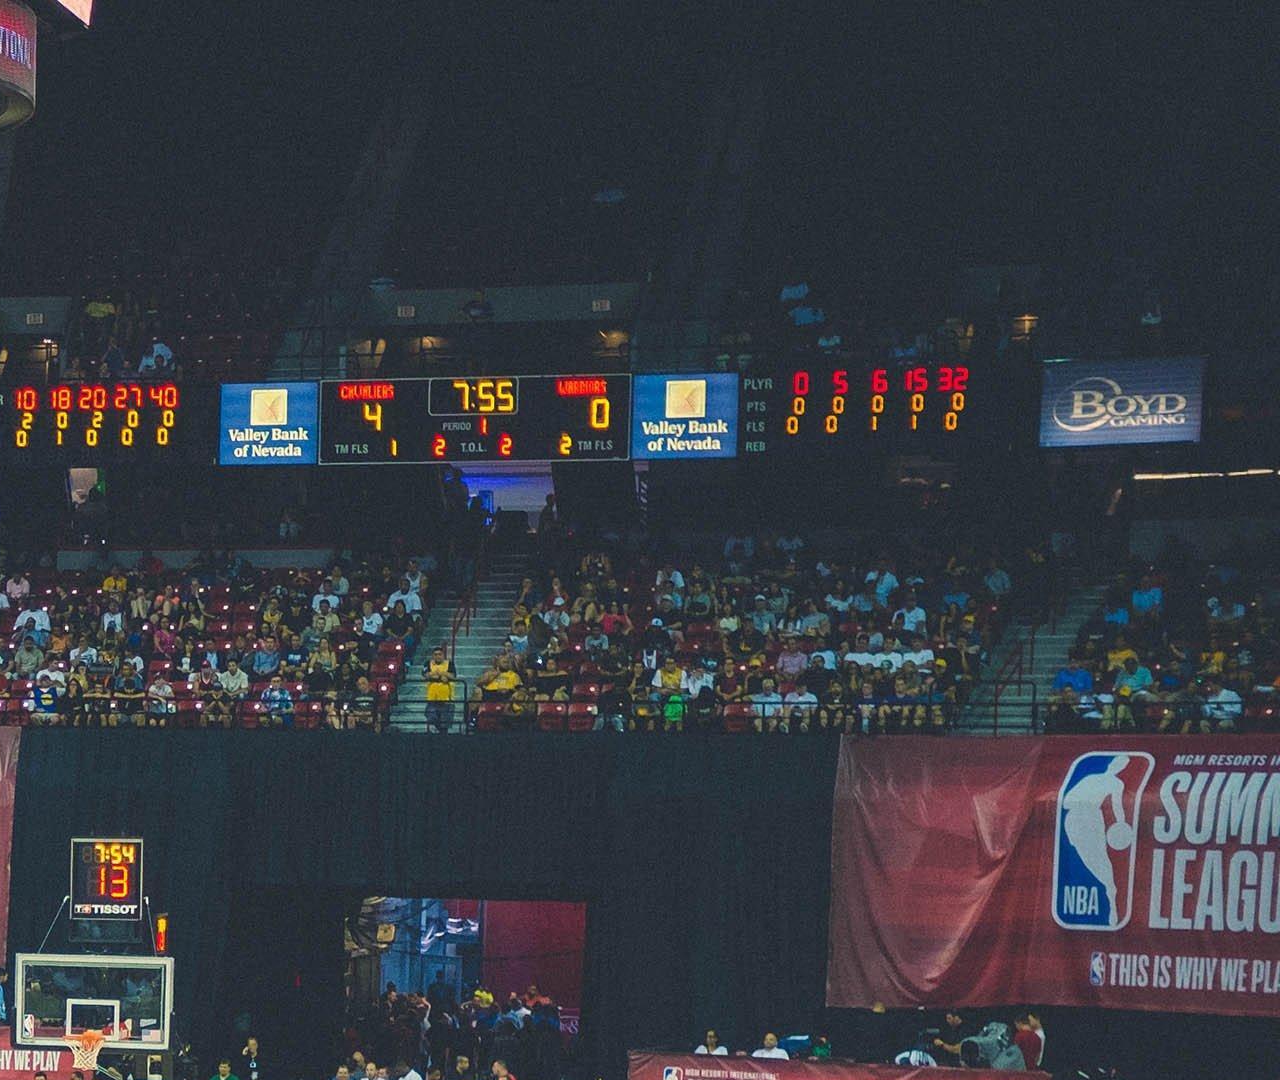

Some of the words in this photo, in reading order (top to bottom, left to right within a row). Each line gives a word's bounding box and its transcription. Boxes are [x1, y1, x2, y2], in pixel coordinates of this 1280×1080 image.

[743, 378, 773, 390] PLYR
[792, 370, 810, 396] 0
[831, 370, 849, 395] 5
[871, 369, 889, 393] 6
[905, 367, 929, 392] 15
[936, 367, 970, 392] 32
[15, 388, 37, 411] 10
[51, 388, 72, 411] 18
[78, 387, 107, 411] 20
[114, 386, 143, 410] 27
[149, 385, 178, 409] 40
[452, 379, 515, 413] 7:55
[746, 401, 766, 412] PTS
[793, 396, 806, 416] 0
[832, 395, 845, 415] 0
[872, 394, 885, 414] 0
[911, 393, 925, 413] 0
[951, 392, 965, 411] 0
[1069, 390, 1187, 420] BOYD
[21, 412, 34, 430] 2
[56, 411, 69, 429] 0
[92, 411, 104, 429] 2
[126, 410, 139, 428] 0
[162, 410, 175, 427] 0
[362, 402, 383, 432] 4
[590, 397, 610, 429] 0
[745, 421, 765, 432] FLS
[786, 415, 799, 435] 0
[825, 414, 838, 434] 0
[944, 411, 958, 431] 0
[1109, 414, 1186, 427] GAMING
[15, 429, 28, 448] 0
[55, 429, 63, 446] 1
[85, 428, 98, 447] 0
[120, 428, 133, 446] 0
[156, 427, 169, 446] 0
[228, 428, 269, 443] Valley
[271, 427, 308, 441] Bank
[642, 421, 686, 437] Valley
[687, 419, 729, 435] Bank
[233, 445, 249, 457] of
[252, 444, 302, 457] Nevada
[334, 444, 350, 454] TM
[351, 444, 369, 454] FLS
[432, 435, 447, 456] 2
[499, 434, 513, 455] 2
[558, 432, 573, 456] 2
[577, 440, 593, 450] TM
[594, 439, 613, 450] FLS
[646, 439, 662, 451] of
[666, 436, 721, 451] Nevada
[745, 442, 766, 452] REB
[1173, 754, 1206, 766] MGM
[1208, 754, 1268, 767] RESORTS
[96, 844, 136, 864] 7:54
[100, 864, 129, 898] 13
[90, 904, 138, 915] TISSOT
[1063, 885, 1099, 916] NBA
[1108, 953, 1150, 987] THIS
[1152, 955, 1171, 988] IS
[1175, 956, 1217, 990] WHY
[1220, 957, 1249, 992] WE
[13, 1050, 31, 1071] WE
[32, 1050, 60, 1072] PLAY
